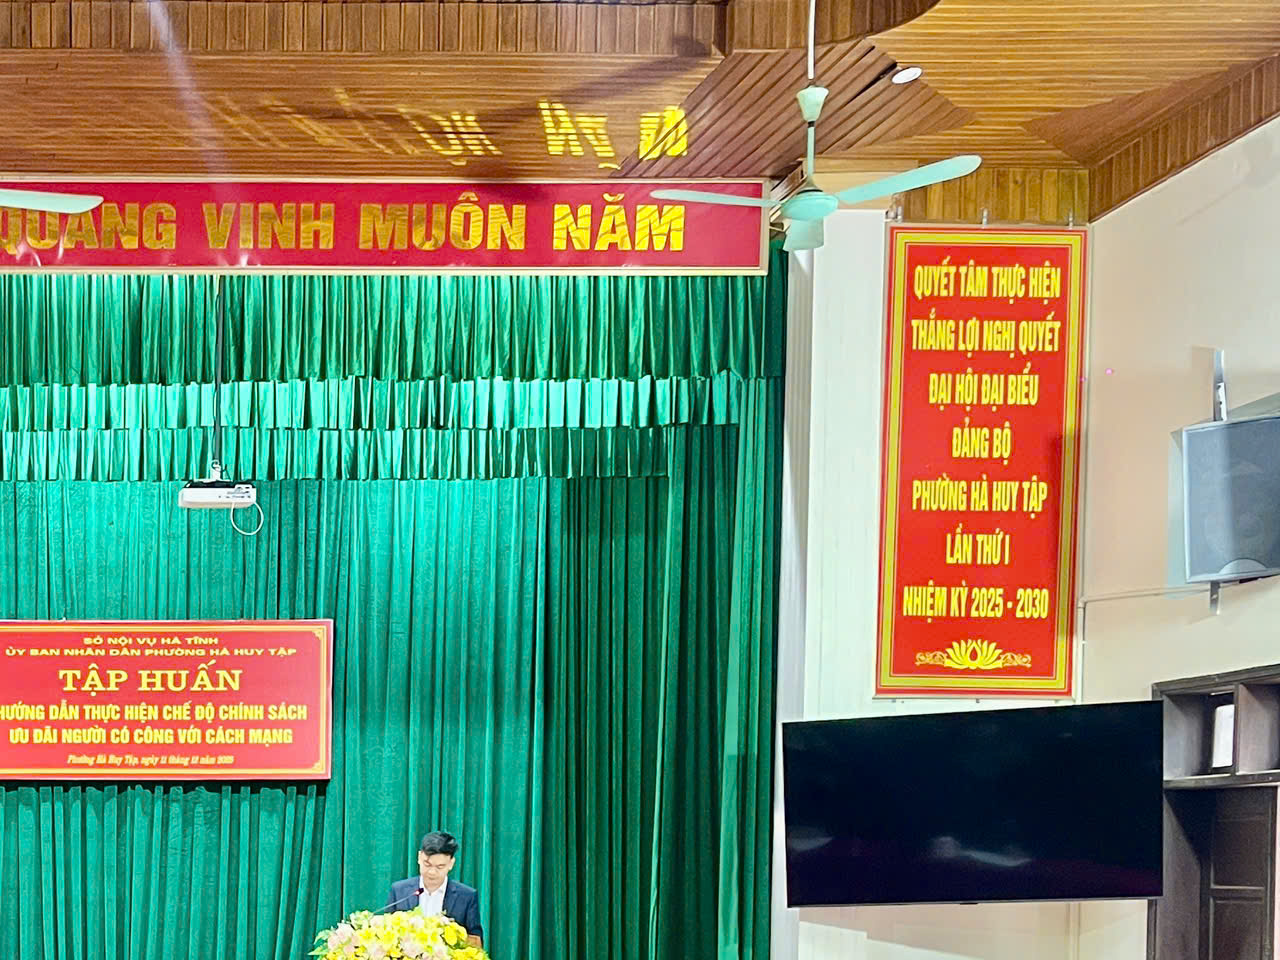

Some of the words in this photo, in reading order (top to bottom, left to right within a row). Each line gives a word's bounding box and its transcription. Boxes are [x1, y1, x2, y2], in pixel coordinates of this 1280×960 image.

[202, 203, 336, 249] VINH
[358, 191, 527, 250] MUÔN
[553, 193, 686, 251] NĂM
[914, 256, 956, 299] QUYẾT
[959, 260, 988, 297] TÂM
[992, 264, 1026, 304] THỰC
[1029, 261, 1061, 304] HIỆN
[912, 308, 955, 350] THẮNG
[958, 319, 979, 357] LỢI
[983, 320, 1016, 358] NGHỊ
[1019, 312, 1061, 354] QUYẾT
[929, 373, 952, 410] ĐẠI
[955, 368, 978, 411] HỘI
[981, 374, 1004, 411] ĐẠI
[1007, 362, 1038, 405] BIỂU
[952, 417, 989, 458] ĐẢNG
[992, 421, 1011, 465] BỘ
[912, 476, 967, 511] PHƯỜNG
[970, 476, 988, 511] HÀ
[992, 481, 1019, 511] HUY
[1022, 476, 1047, 518] TẬP
[946, 523, 972, 564] LẦN
[976, 528, 1003, 564] THỨ
[1005, 535, 1009, 564] I
[903, 580, 947, 623] NHIỆM
[950, 581, 968, 617] KỲ
[971, 587, 1003, 617] 2025
[1016, 588, 1049, 618] 2030
[29, 648, 60, 656] BAN
[63, 647, 106, 656] NHÂN
[109, 647, 141, 656] DÂN
[144, 647, 206, 656] PHƯỜNG
[233, 648, 265, 656] HUY
[267, 647, 297, 657] TẬP
[107, 636, 133, 647] NỘI
[136, 637, 158, 647] VỤ
[58, 662, 129, 697] TẬP
[137, 658, 243, 692] HUẤN
[48, 698, 80, 720] DẪN
[82, 703, 121, 723] THỰC
[123, 701, 159, 723] HIỆN
[162, 700, 192, 720] CHẾ
[194, 701, 215, 723] ĐỘ
[218, 701, 264, 720] CHÍNH
[267, 701, 308, 720] SÁCH
[9, 727, 30, 744] ƯU
[32, 725, 58, 744] ĐÃI
[61, 724, 107, 744] NGƯỜI
[109, 724, 130, 744] CÓ
[133, 725, 174, 744] CÔNG
[177, 724, 202, 744] VỚI
[205, 725, 245, 744] CÁCH
[248, 728, 293, 747] MẠNG
